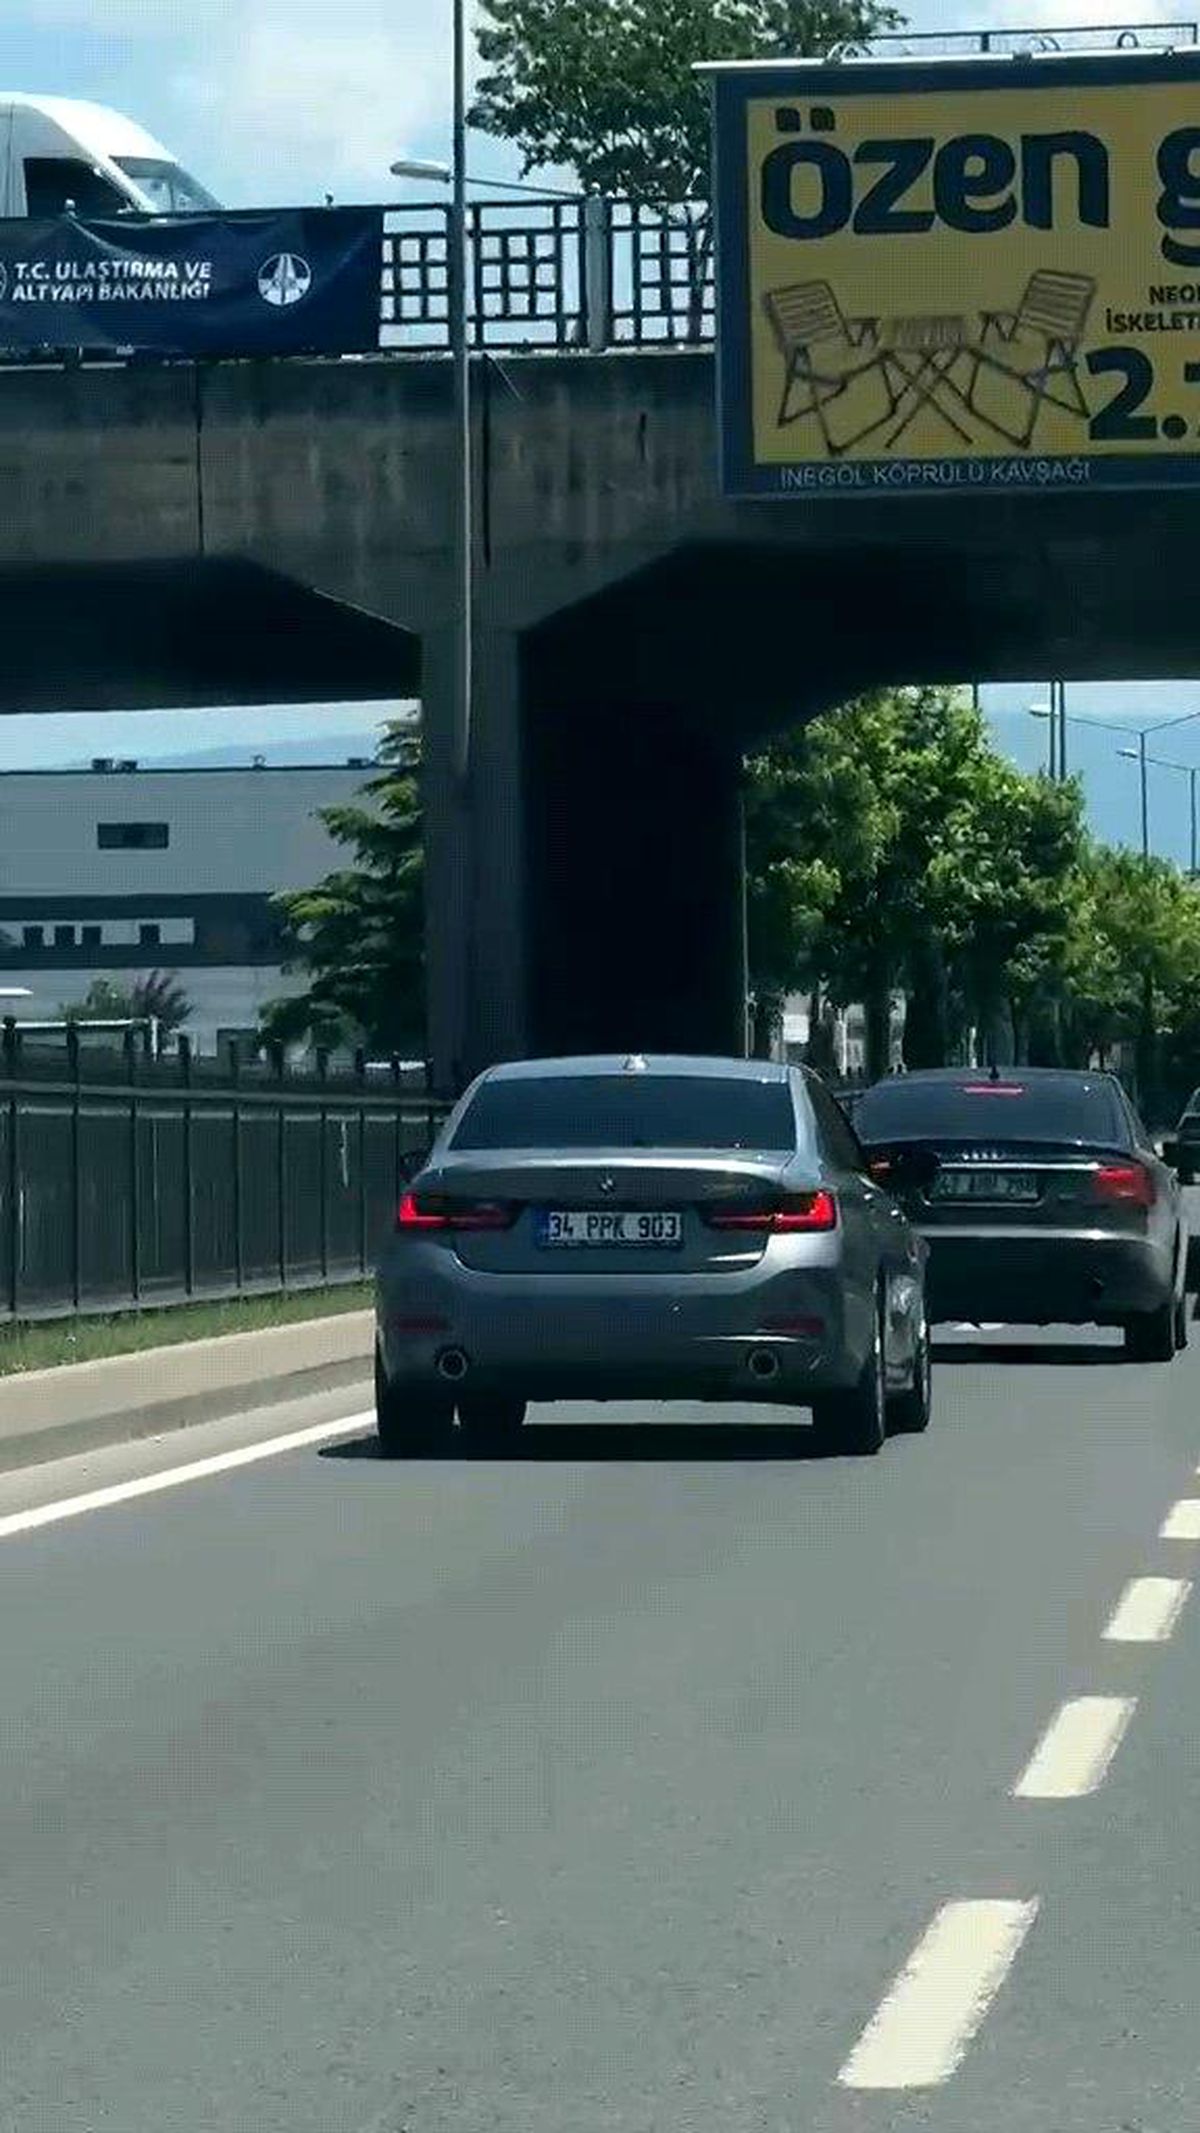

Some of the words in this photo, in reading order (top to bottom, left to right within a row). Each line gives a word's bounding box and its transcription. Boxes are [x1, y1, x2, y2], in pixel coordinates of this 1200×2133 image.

[760, 106, 1110, 240] özen
[15, 262, 49, 280] T.C.
[55, 261, 178, 282] ULAŞTIRMA
[184, 262, 211, 279] VE
[12, 284, 94, 301] ALTYAPI
[99, 280, 210, 300] BAKANLIĞI
[1149, 285, 1200, 304] NEO
[1105, 308, 1200, 333] İSKELET
[1085, 346, 1200, 440] 2.
[551, 1215, 574, 1238] 34
[587, 1216, 626, 1238] PPK
[638, 1216, 678, 1239] 903
